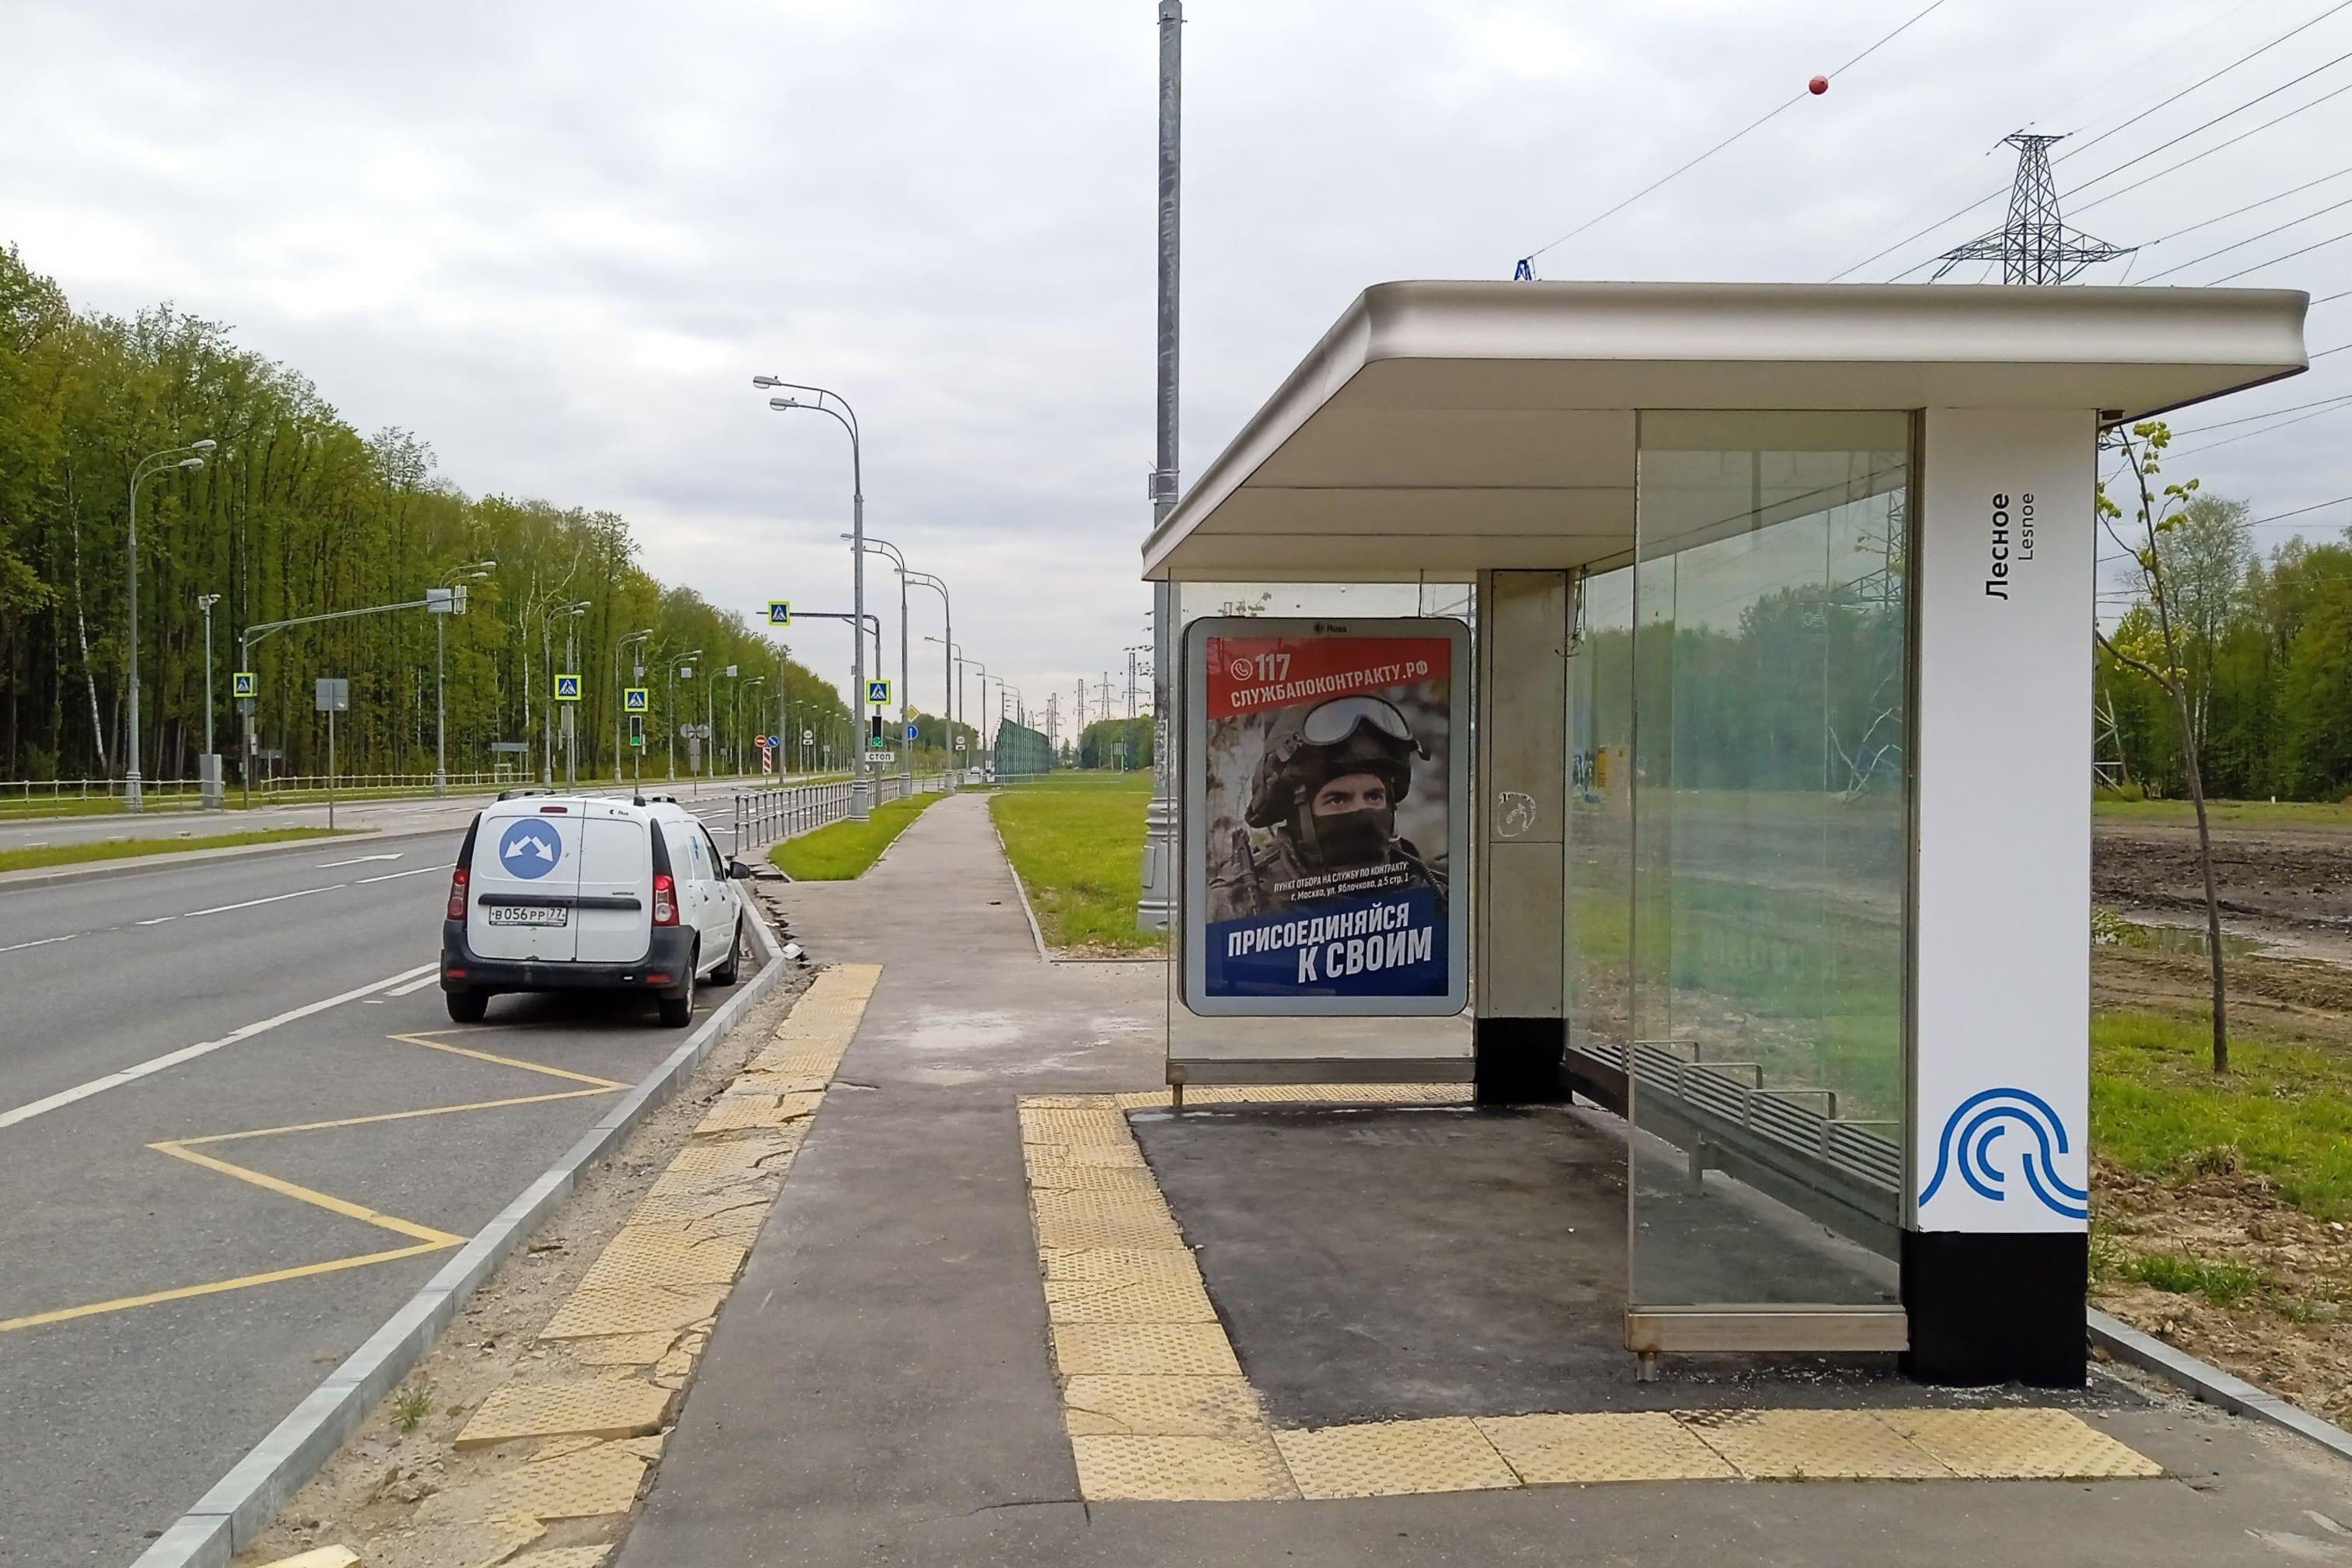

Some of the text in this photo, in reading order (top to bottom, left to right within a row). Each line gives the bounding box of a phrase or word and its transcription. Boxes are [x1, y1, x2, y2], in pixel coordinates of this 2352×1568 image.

[1985, 493, 2009, 600] Лесное
[2018, 492, 2034, 560] Lesnoe
[1230, 660, 1429, 708] СЛУЖБАПОКОНТРАКТУ.РФ
[1255, 653, 1291, 681] 117
[1274, 880, 1296, 893] ПУНКТ
[1296, 876, 1321, 889] ОТБОРА
[1322, 873, 1332, 885] НА
[1332, 870, 1360, 883] СЛУЖБУ
[1360, 867, 1370, 878] ПО
[1291, 893, 1297, 901] г.
[1297, 888, 1326, 901] Москва,
[1327, 887, 1337, 898] ул.
[1338, 880, 1377, 894] Яблочкова,
[1389, 875, 1404, 886] стр.
[1405, 872, 1409, 882] 1
[1227, 901, 1409, 957] ПРИСОЕДИНЯЙСЯ
[1297, 926, 1433, 984] К СВОИМ
